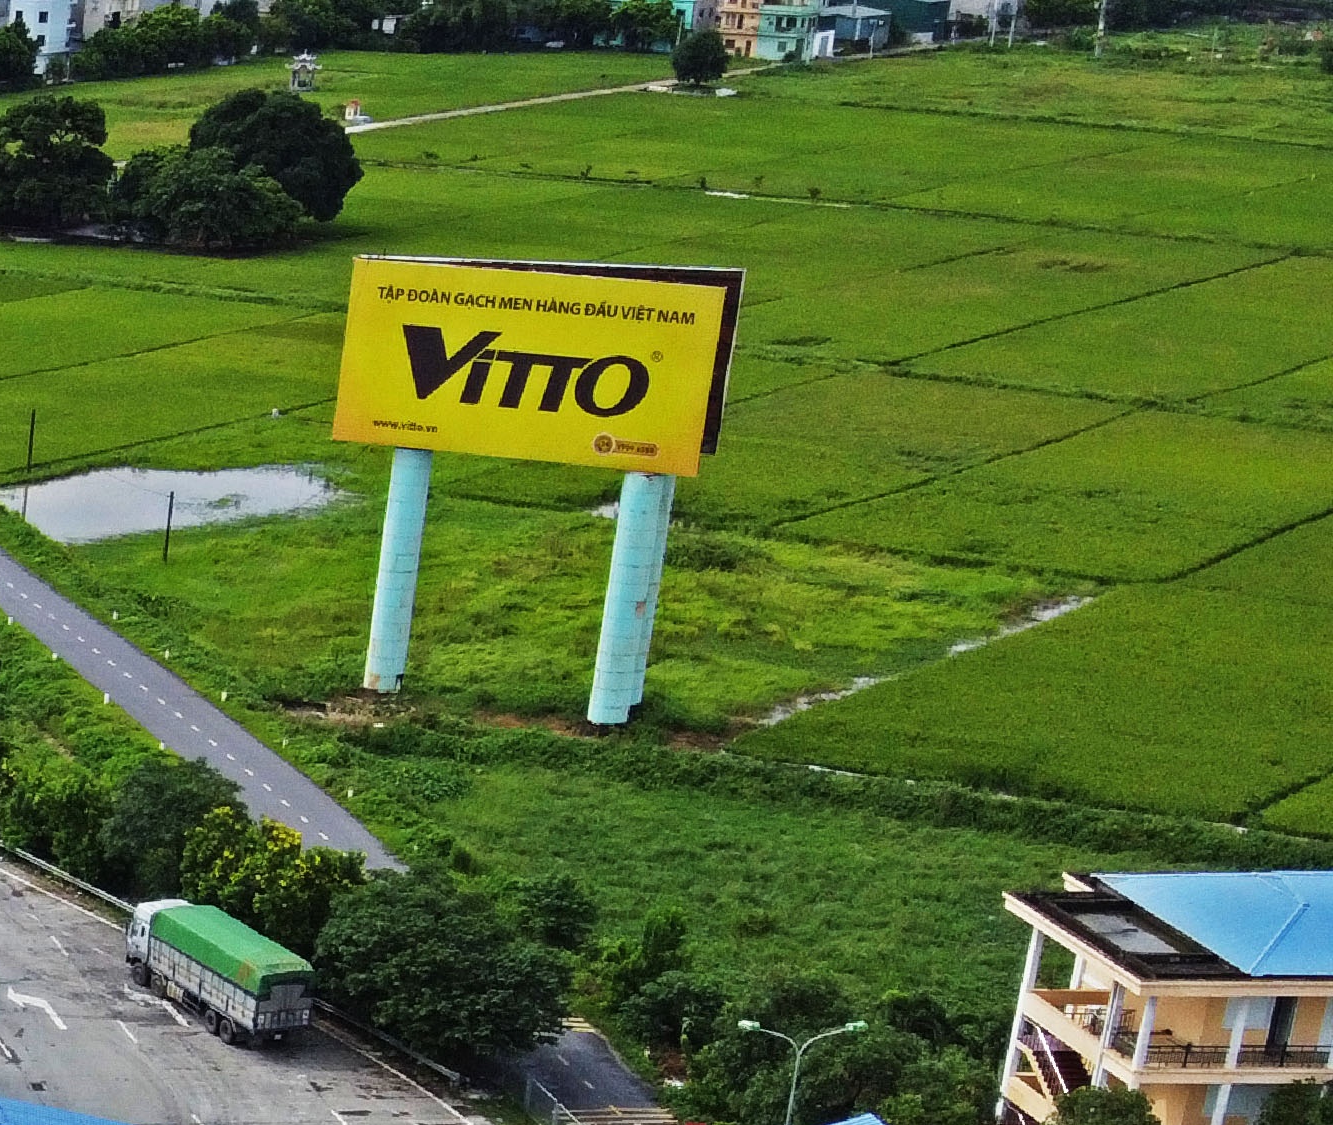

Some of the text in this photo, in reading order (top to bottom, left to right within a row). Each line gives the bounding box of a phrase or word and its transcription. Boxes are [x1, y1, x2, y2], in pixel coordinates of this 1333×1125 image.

[377, 285, 405, 306] TẬP
[407, 287, 451, 306] ĐOÀN
[453, 291, 497, 311] GẠCH
[499, 297, 532, 312] MEN
[536, 297, 581, 316] HÀNG
[621, 303, 655, 324] VIỆT
[657, 310, 695, 326] NAM
